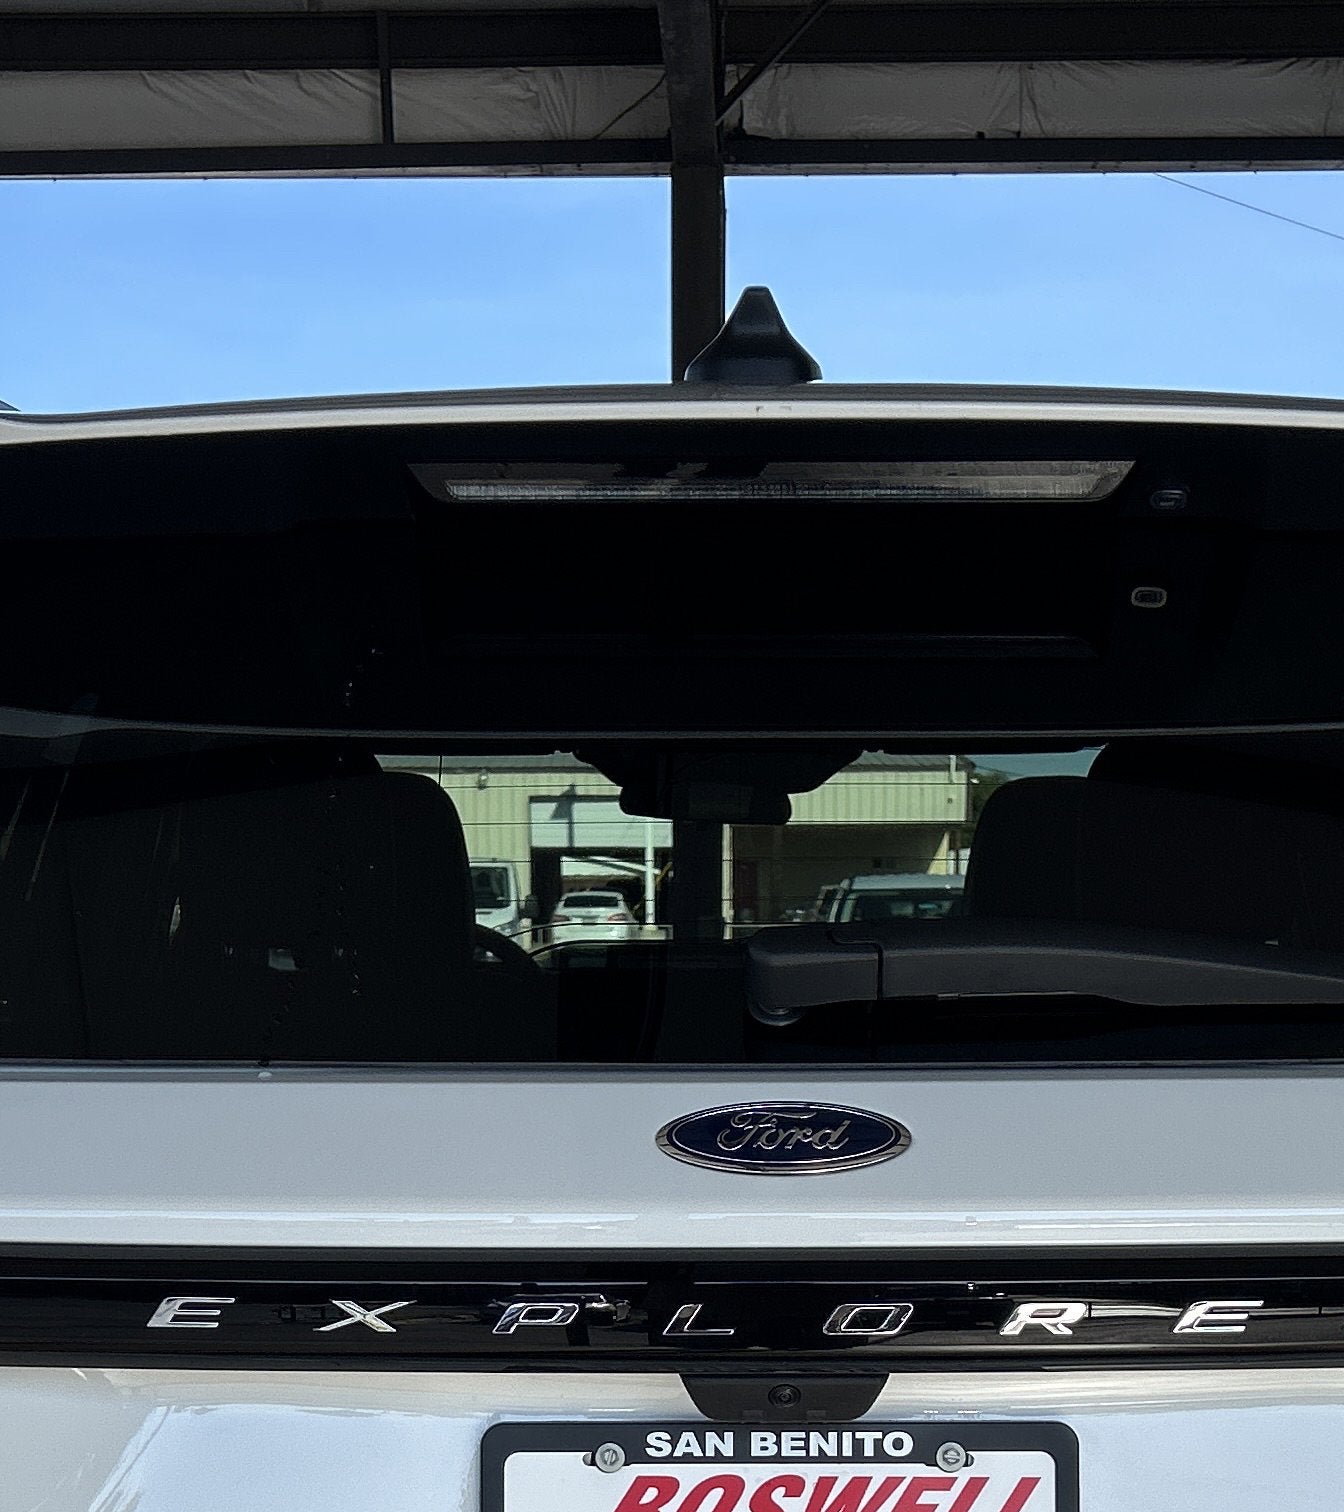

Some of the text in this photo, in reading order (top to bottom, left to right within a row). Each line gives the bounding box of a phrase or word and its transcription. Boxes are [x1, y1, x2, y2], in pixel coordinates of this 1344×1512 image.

[716, 1111, 852, 1151] Ford
[644, 1430, 915, 1458] SAN BENITO
